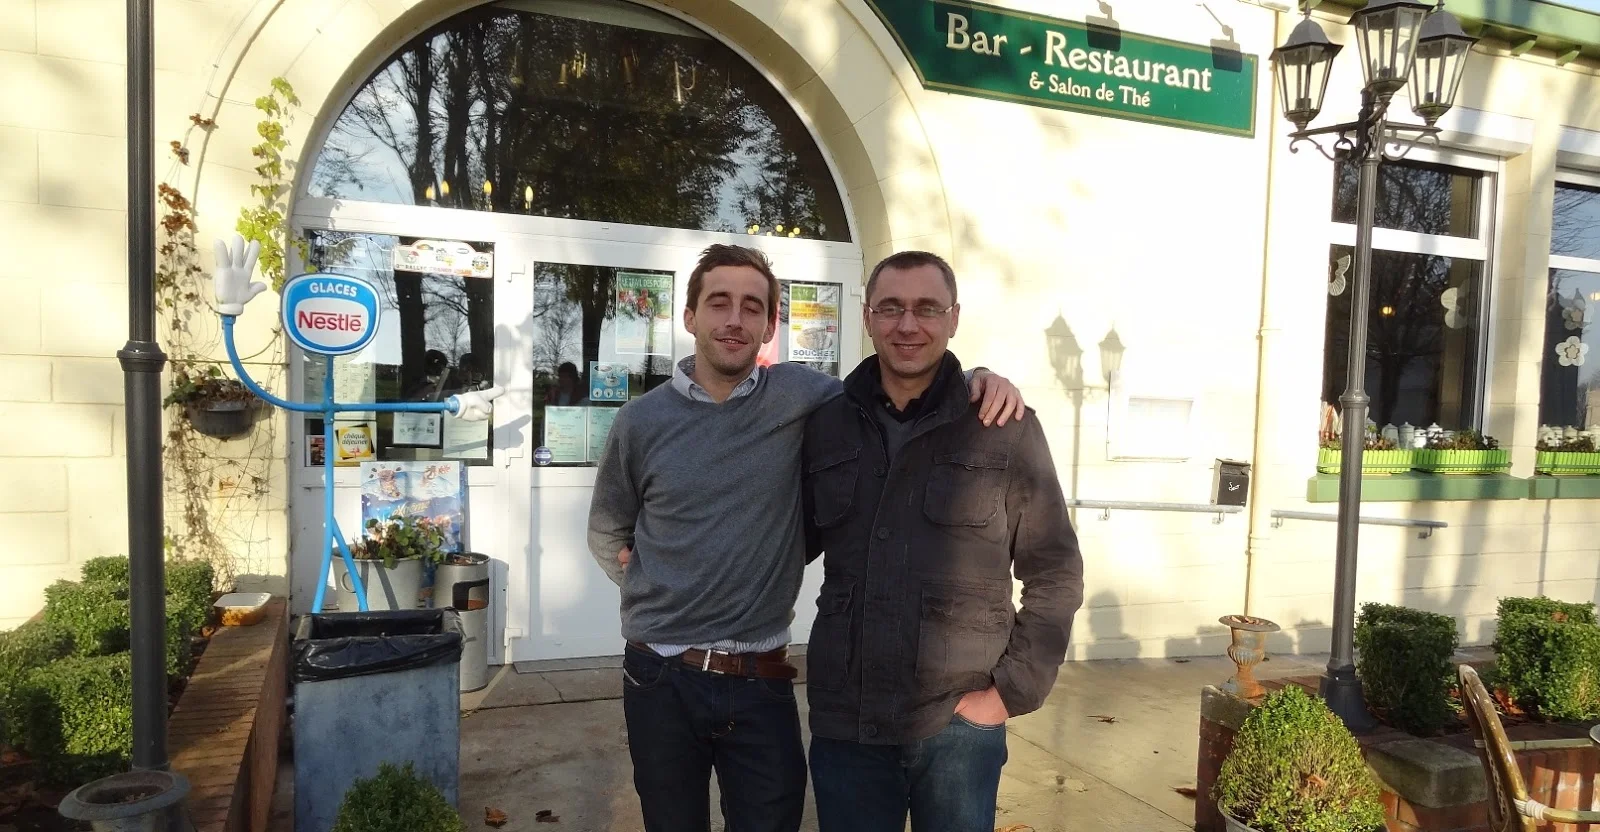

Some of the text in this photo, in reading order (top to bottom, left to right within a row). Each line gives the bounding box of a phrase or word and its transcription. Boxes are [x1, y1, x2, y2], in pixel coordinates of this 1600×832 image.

[946, 12, 1008, 56] Bar
[1044, 30, 1212, 92] Restaurant
[1029, 71, 1151, 107] & Salon de Thé
[309, 282, 357, 297] GLACES
[793, 349, 835, 357] SOUCHEZ
